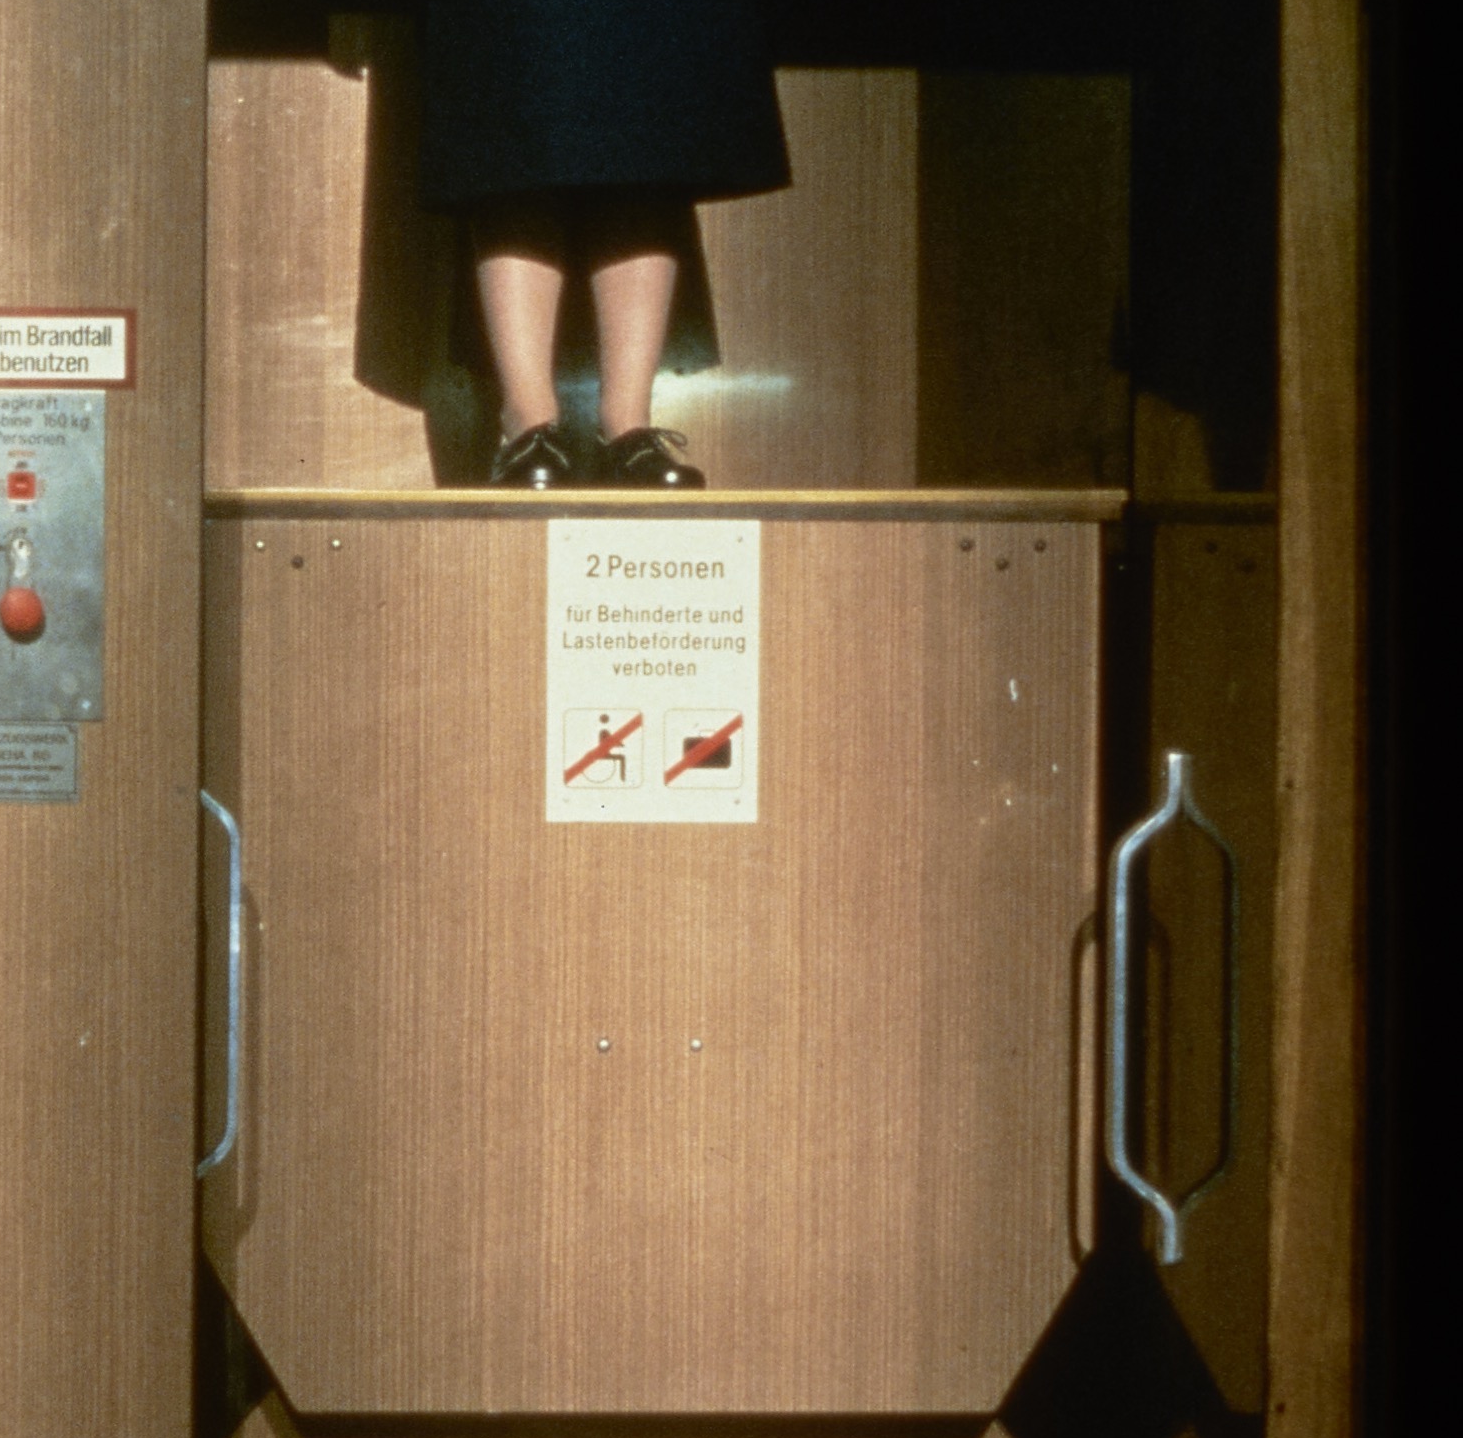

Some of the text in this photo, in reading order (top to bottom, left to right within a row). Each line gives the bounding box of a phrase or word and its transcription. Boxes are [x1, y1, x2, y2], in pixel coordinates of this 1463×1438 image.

[26, 325, 113, 347] Brandfall
[0, 352, 89, 373] benutzen
[586, 554, 726, 579] 2 Personen
[566, 604, 744, 624] für Behinderte und
[562, 631, 746, 654] Lastenbeförderung
[612, 659, 698, 677] verboten
